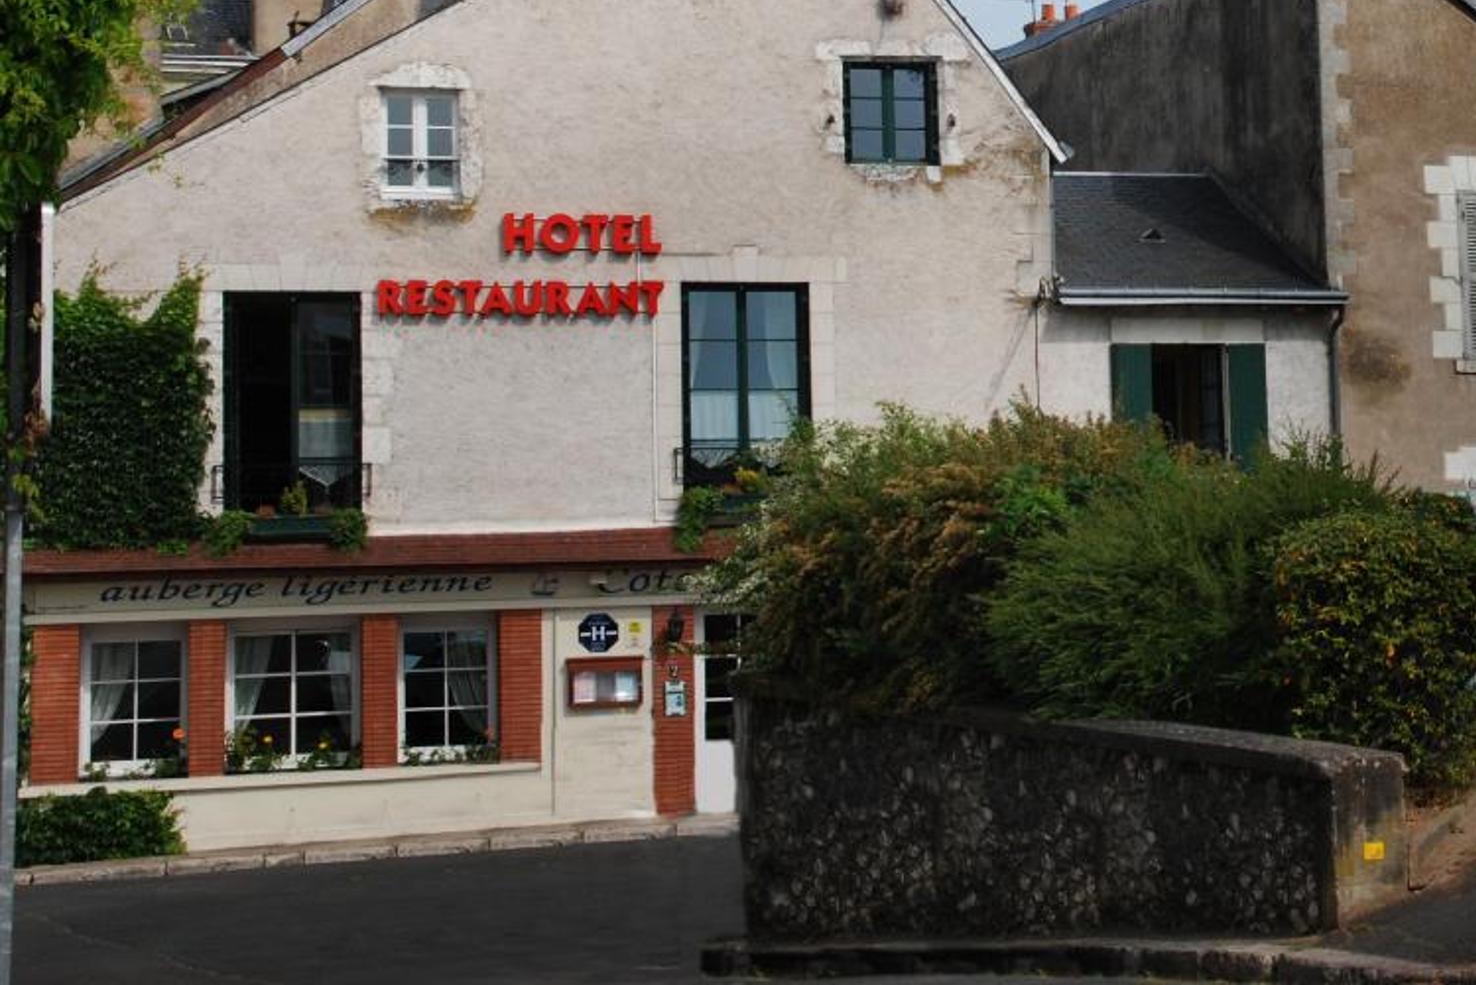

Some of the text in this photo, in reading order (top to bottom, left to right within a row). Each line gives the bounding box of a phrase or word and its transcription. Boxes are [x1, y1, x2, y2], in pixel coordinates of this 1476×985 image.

[502, 213, 662, 256] HOTEL
[376, 280, 664, 317] RESTAURANT
[101, 576, 266, 607] auberge
